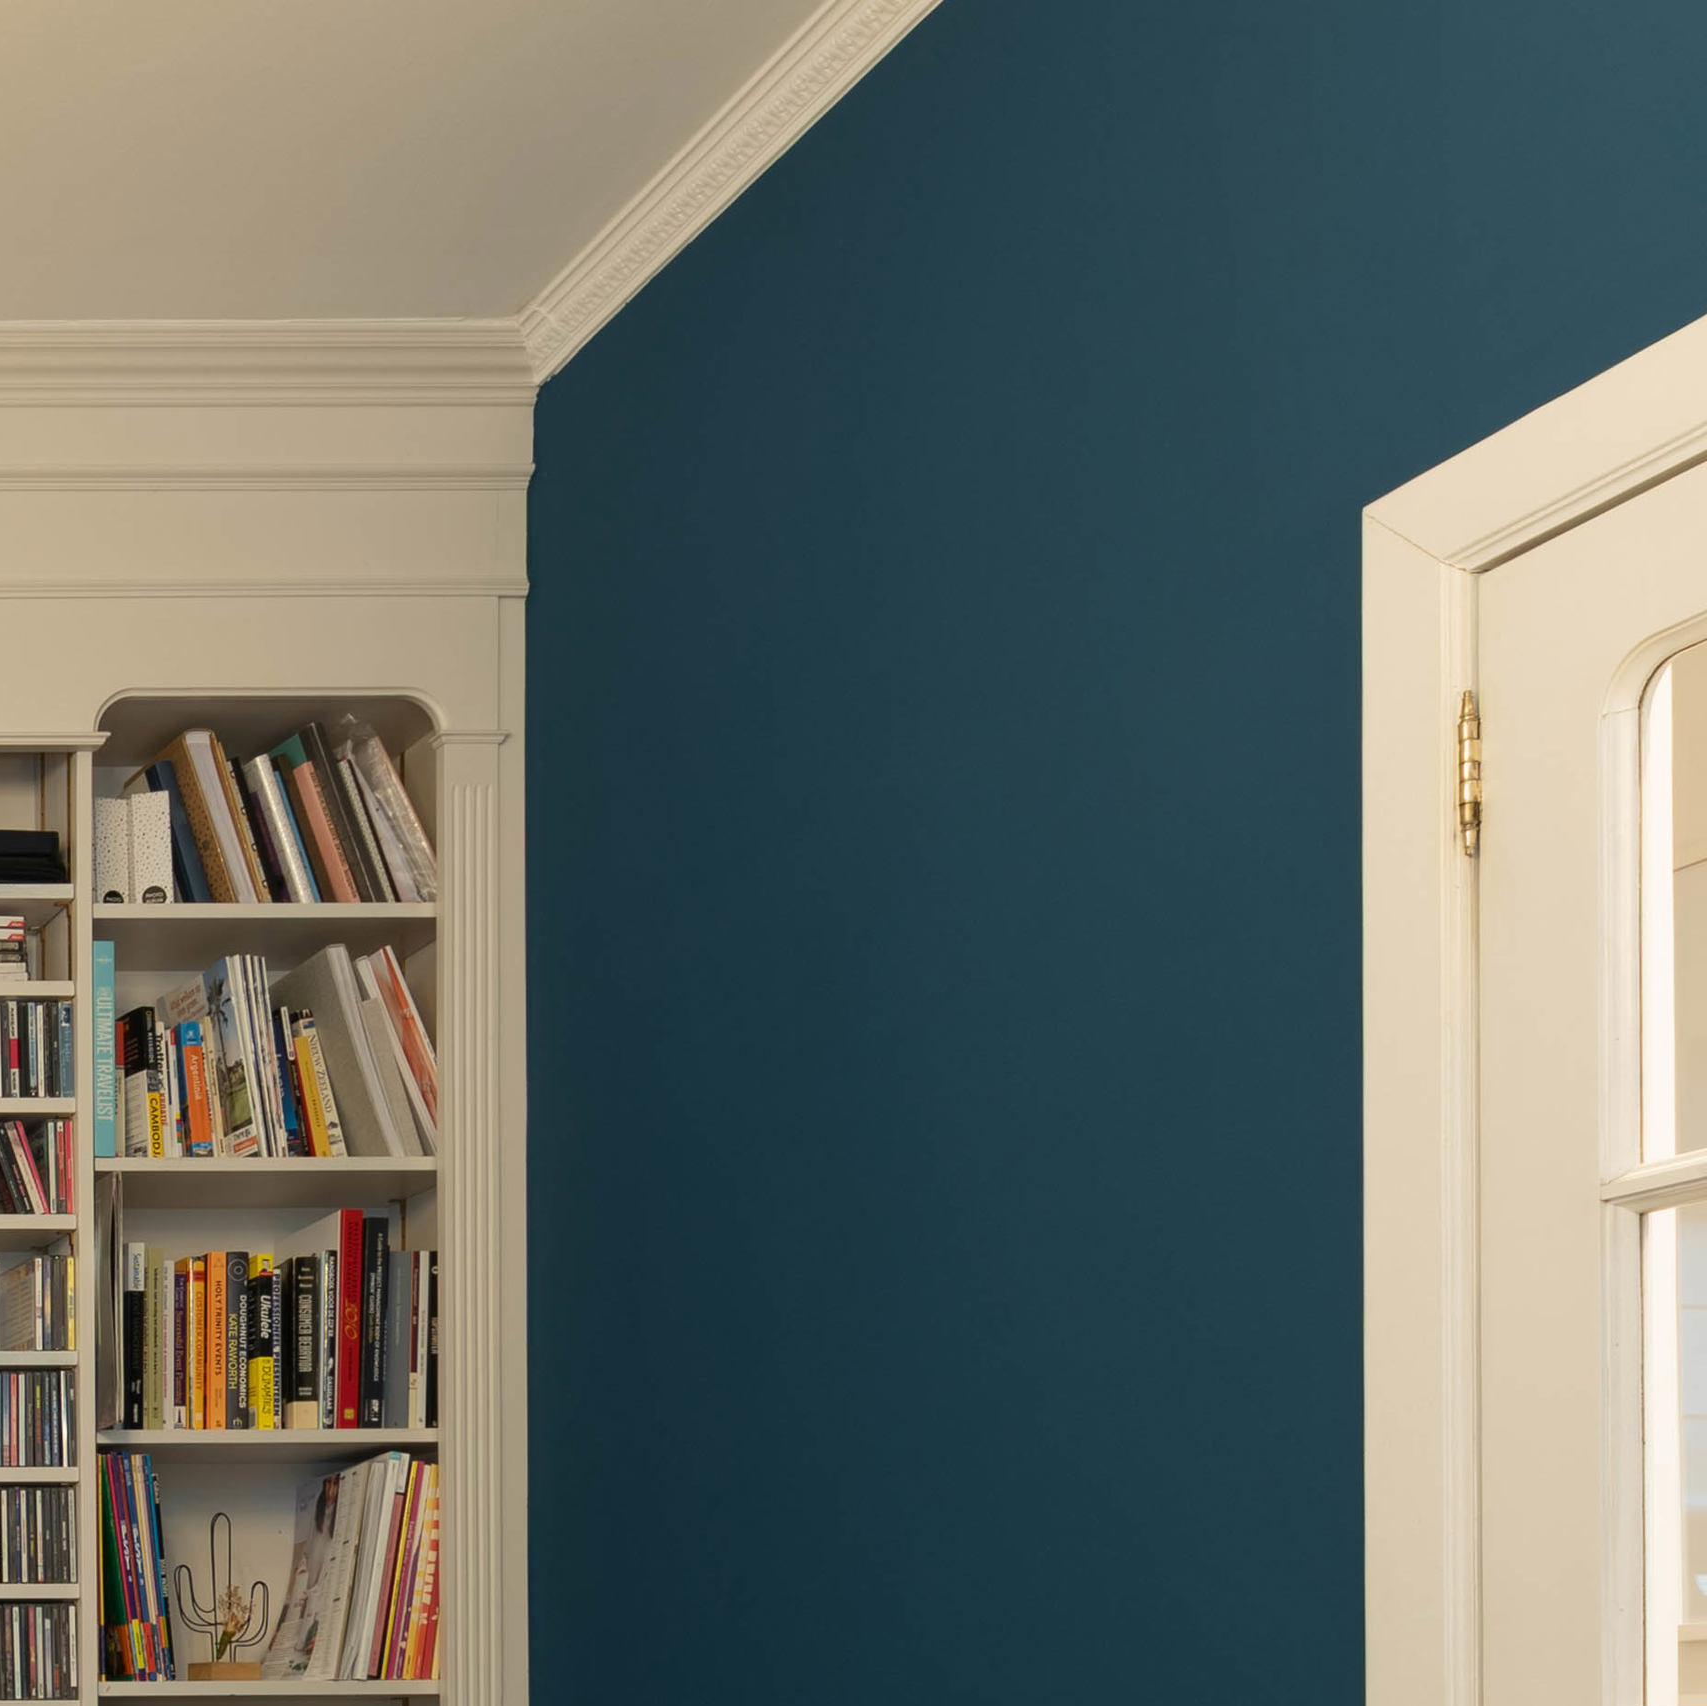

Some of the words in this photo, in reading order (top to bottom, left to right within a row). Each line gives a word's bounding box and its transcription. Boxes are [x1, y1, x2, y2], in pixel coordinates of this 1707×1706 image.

[96, 1003, 112, 1054] ULTIMATE
[97, 1059, 113, 1122] TRAVELIST
[307, 1035, 322, 1069] NIEUW
[316, 1071, 332, 1113] ZEELAND
[132, 1253, 142, 1288] Sustainable
[229, 1314, 238, 1336] KATE
[239, 1295, 247, 1348] DOUGHNUT
[261, 1295, 271, 1338] Ukulele
[299, 1295, 312, 1334] CONSUMER
[229, 1339, 238, 1389] RAWORTH
[299, 1336, 312, 1372] BEHAVIOR
[239, 1350, 247, 1408] ECONOMICS
[262, 1365, 271, 1414] DUMMIES
